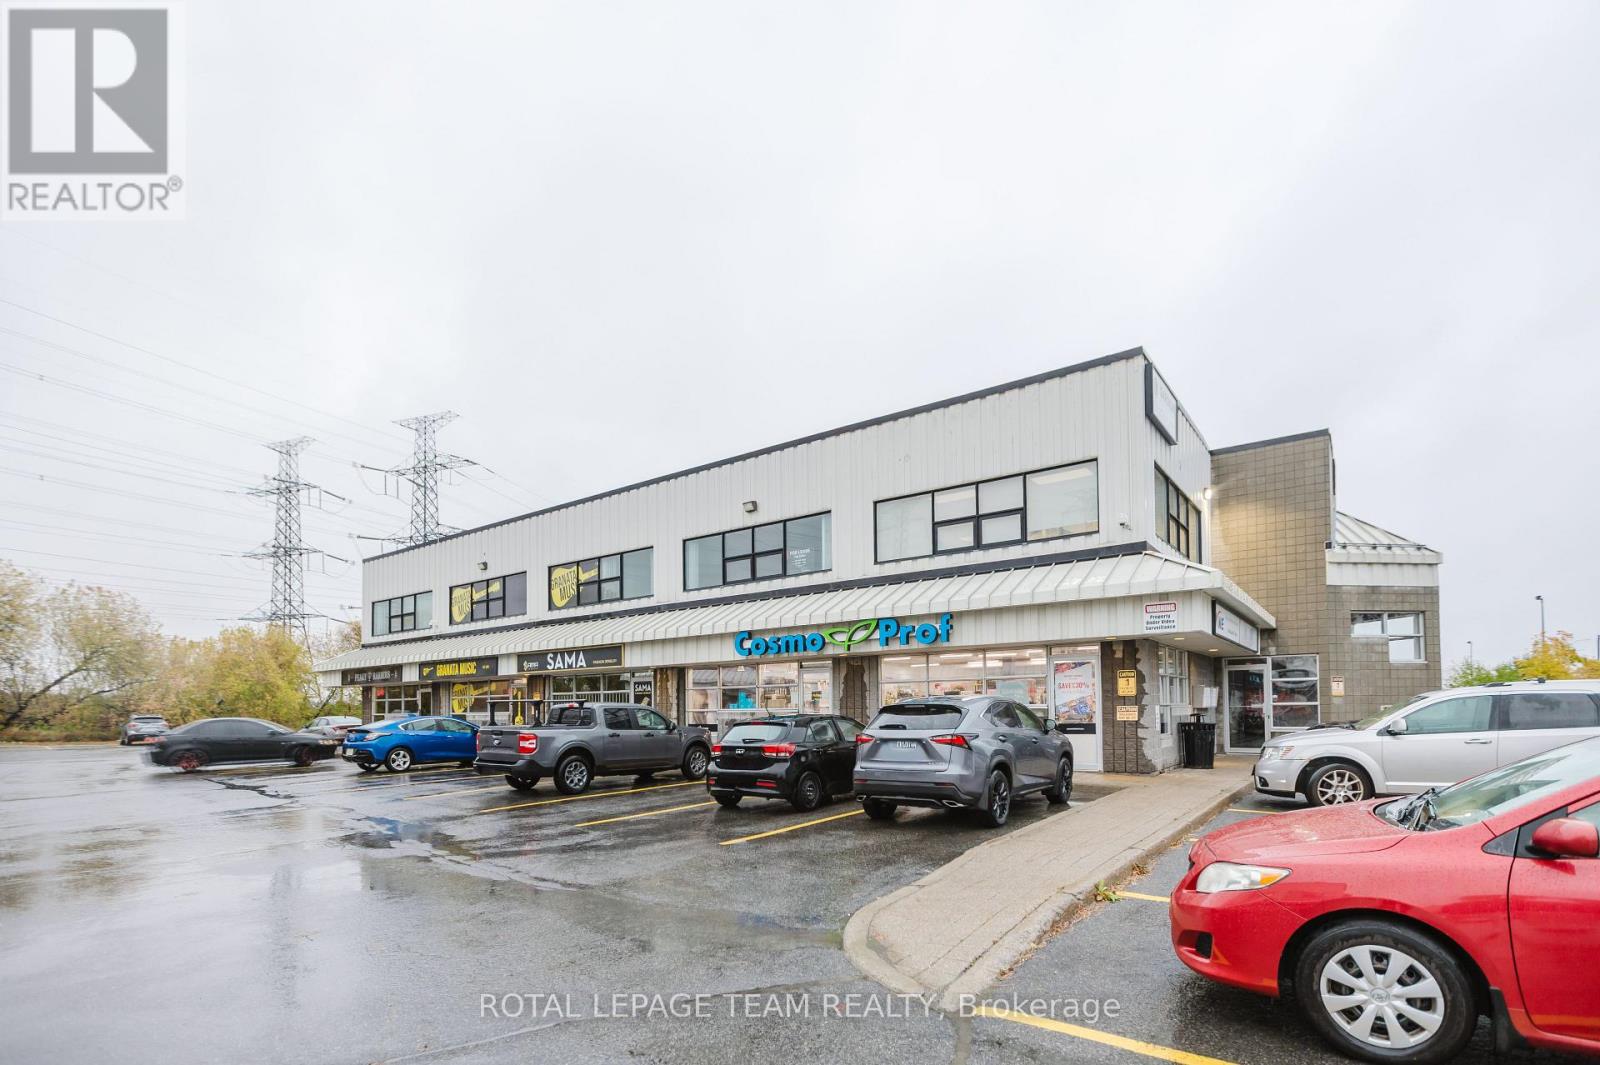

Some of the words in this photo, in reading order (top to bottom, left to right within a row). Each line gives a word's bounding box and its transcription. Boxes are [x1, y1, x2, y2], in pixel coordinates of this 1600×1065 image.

[734, 630, 825, 656] Cosmo
[879, 613, 953, 647] Prof
[436, 663, 459, 676] GRANATA
[459, 661, 477, 675] MUSIC
[547, 651, 586, 669] SAMA
